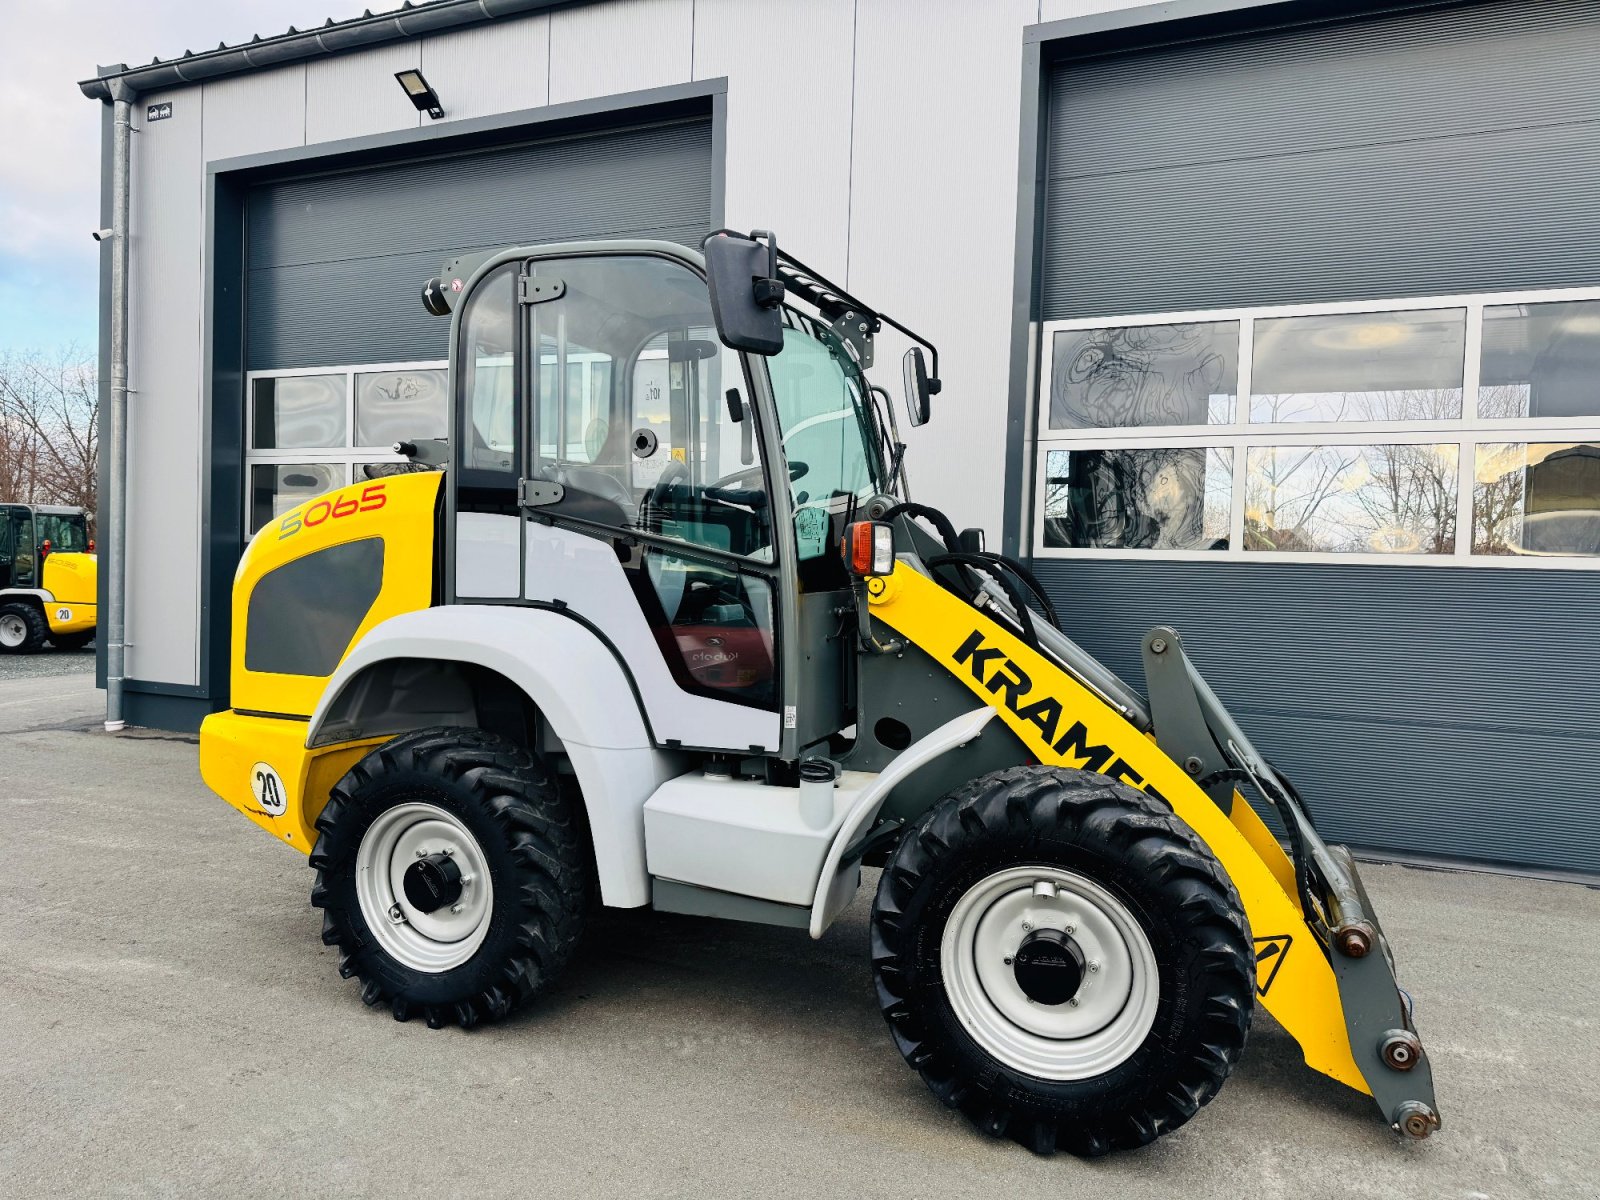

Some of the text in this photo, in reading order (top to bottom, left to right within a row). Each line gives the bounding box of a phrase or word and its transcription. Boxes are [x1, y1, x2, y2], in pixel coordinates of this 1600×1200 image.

[278, 483, 387, 540] 5065
[60, 609, 70, 620] 20
[257, 771, 281, 807] 20
